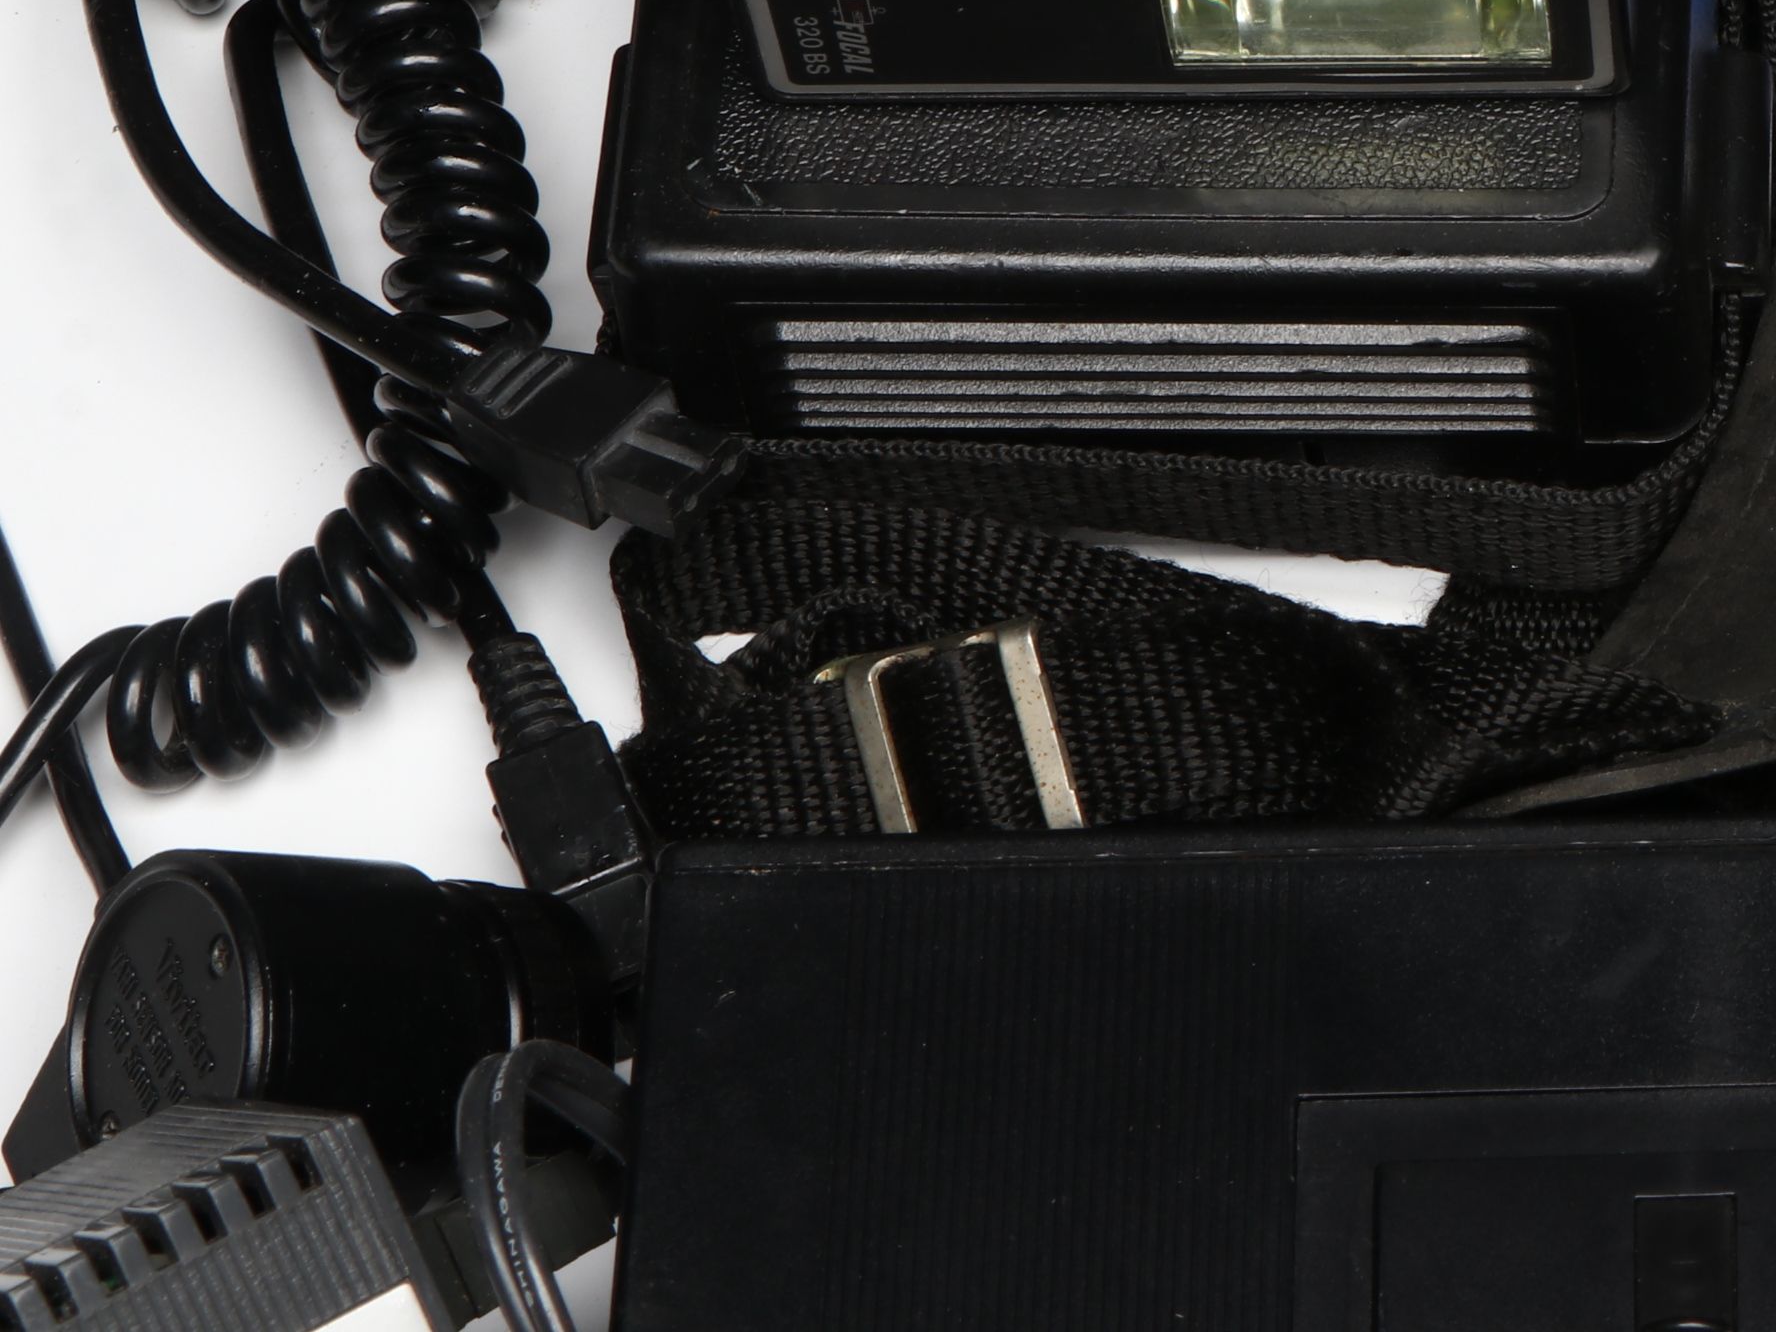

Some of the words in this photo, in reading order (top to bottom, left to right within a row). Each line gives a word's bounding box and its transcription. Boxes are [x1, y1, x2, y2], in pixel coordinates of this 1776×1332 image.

[793, 16, 824, 49] 320
[833, 20, 875, 74] FOCAL
[803, 52, 831, 75] BS
